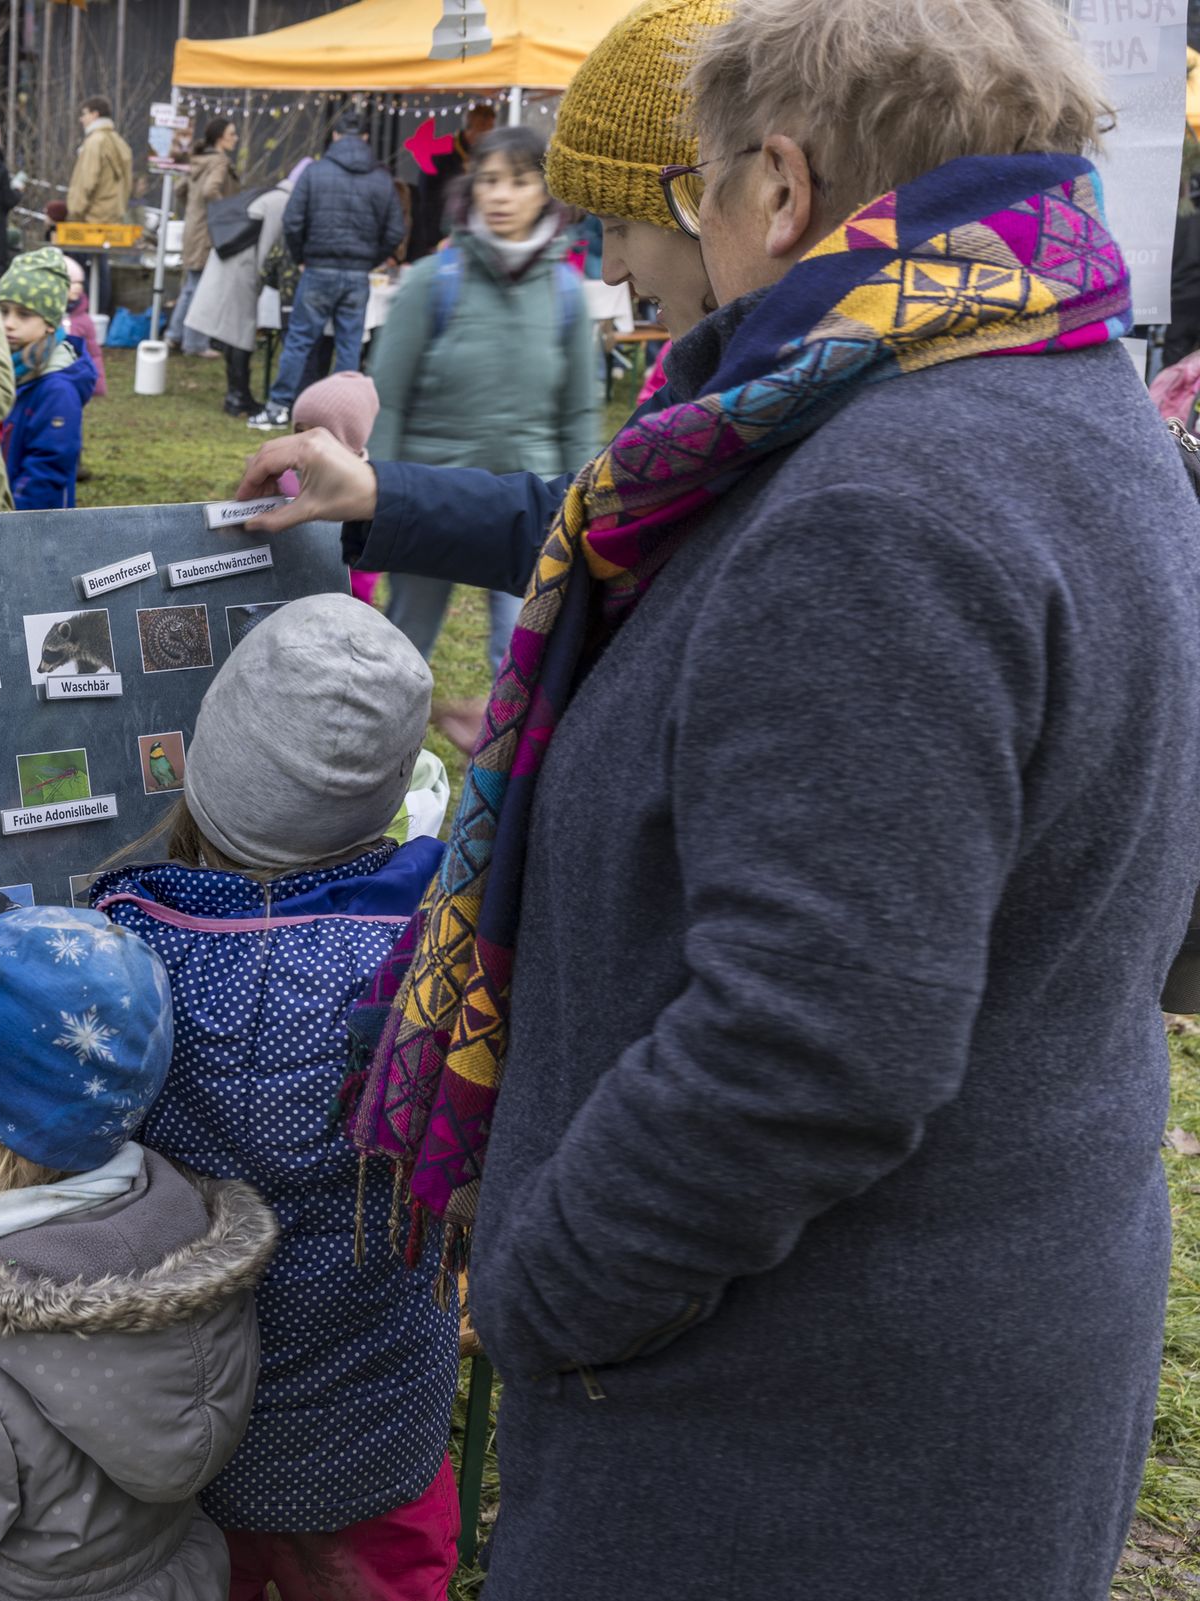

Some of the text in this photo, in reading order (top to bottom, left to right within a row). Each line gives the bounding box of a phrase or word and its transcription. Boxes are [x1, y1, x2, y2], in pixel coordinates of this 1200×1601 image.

[88, 560, 151, 590] Bienenfresser
[176, 552, 268, 579] Taubenschwänzchen
[60, 679, 110, 694] Waschbär
[13, 802, 109, 827] Frühe Adonislibelle
